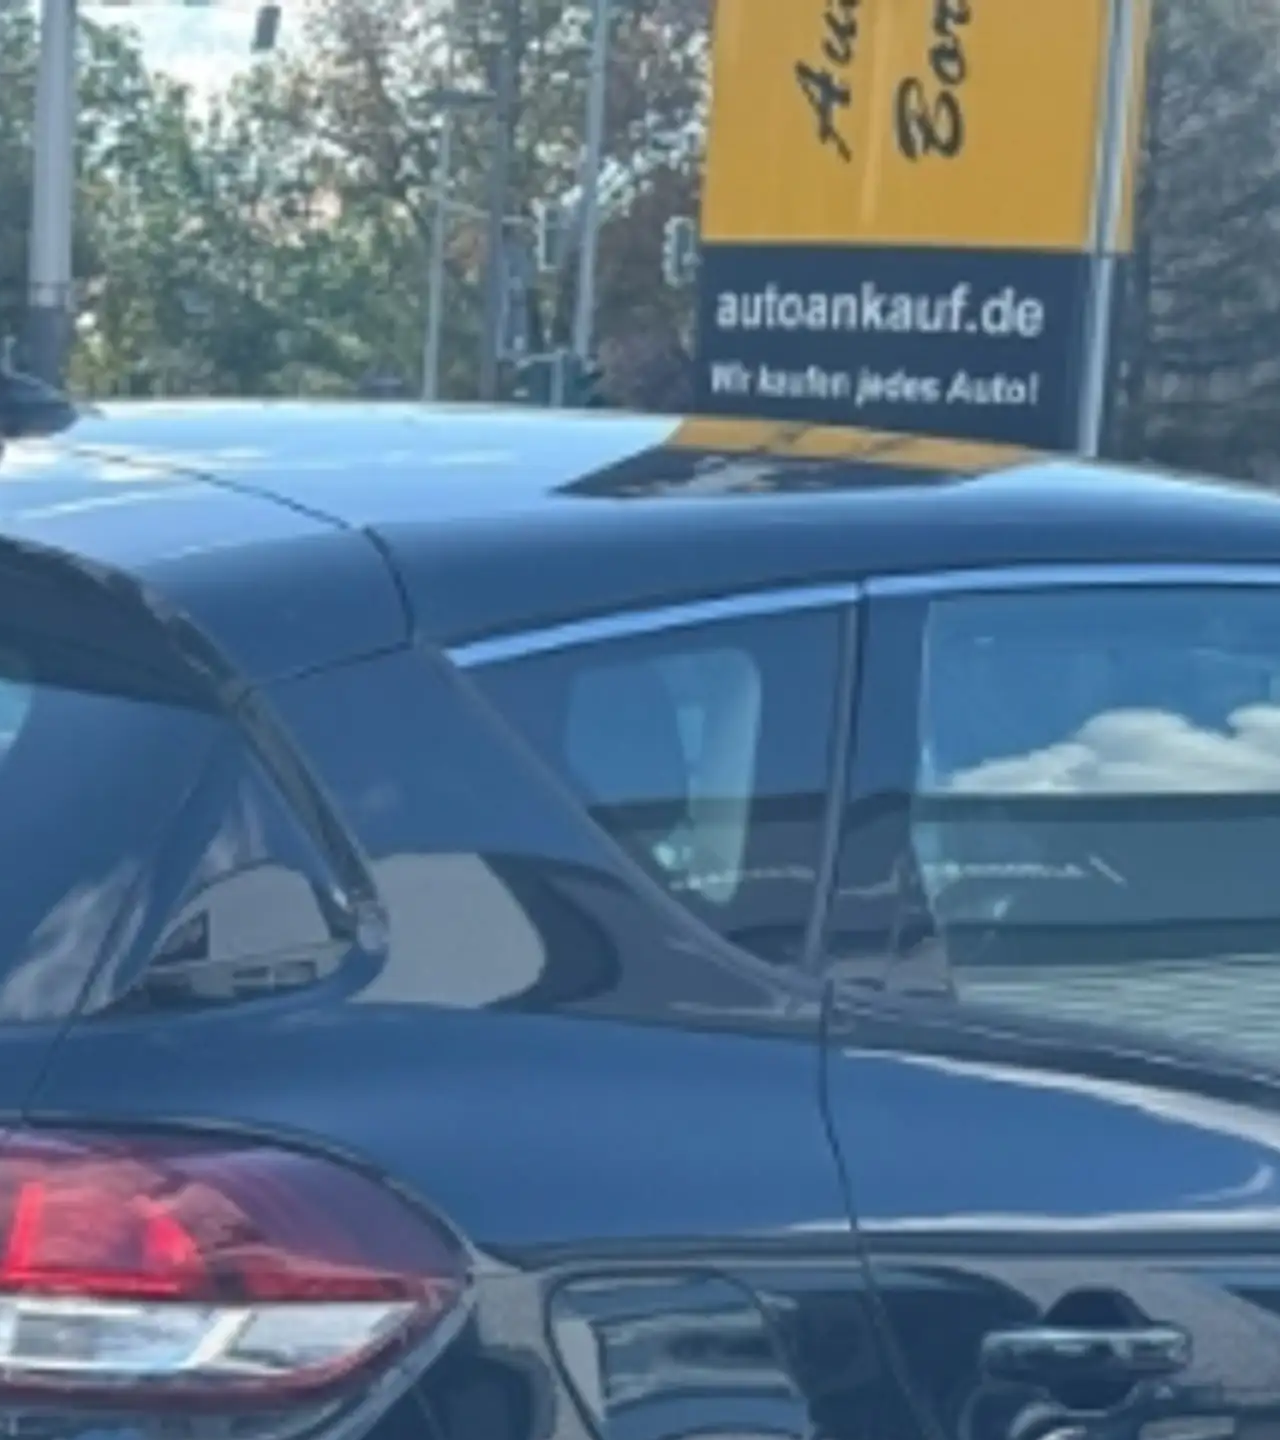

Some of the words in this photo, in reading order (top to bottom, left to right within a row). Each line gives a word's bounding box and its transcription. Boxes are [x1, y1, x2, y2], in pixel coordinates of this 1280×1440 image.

[795, 0, 858, 163] Au
[716, 281, 1044, 337] autoankauf.de
[855, 366, 941, 408] jedes
[947, 368, 1039, 405] Auto!
